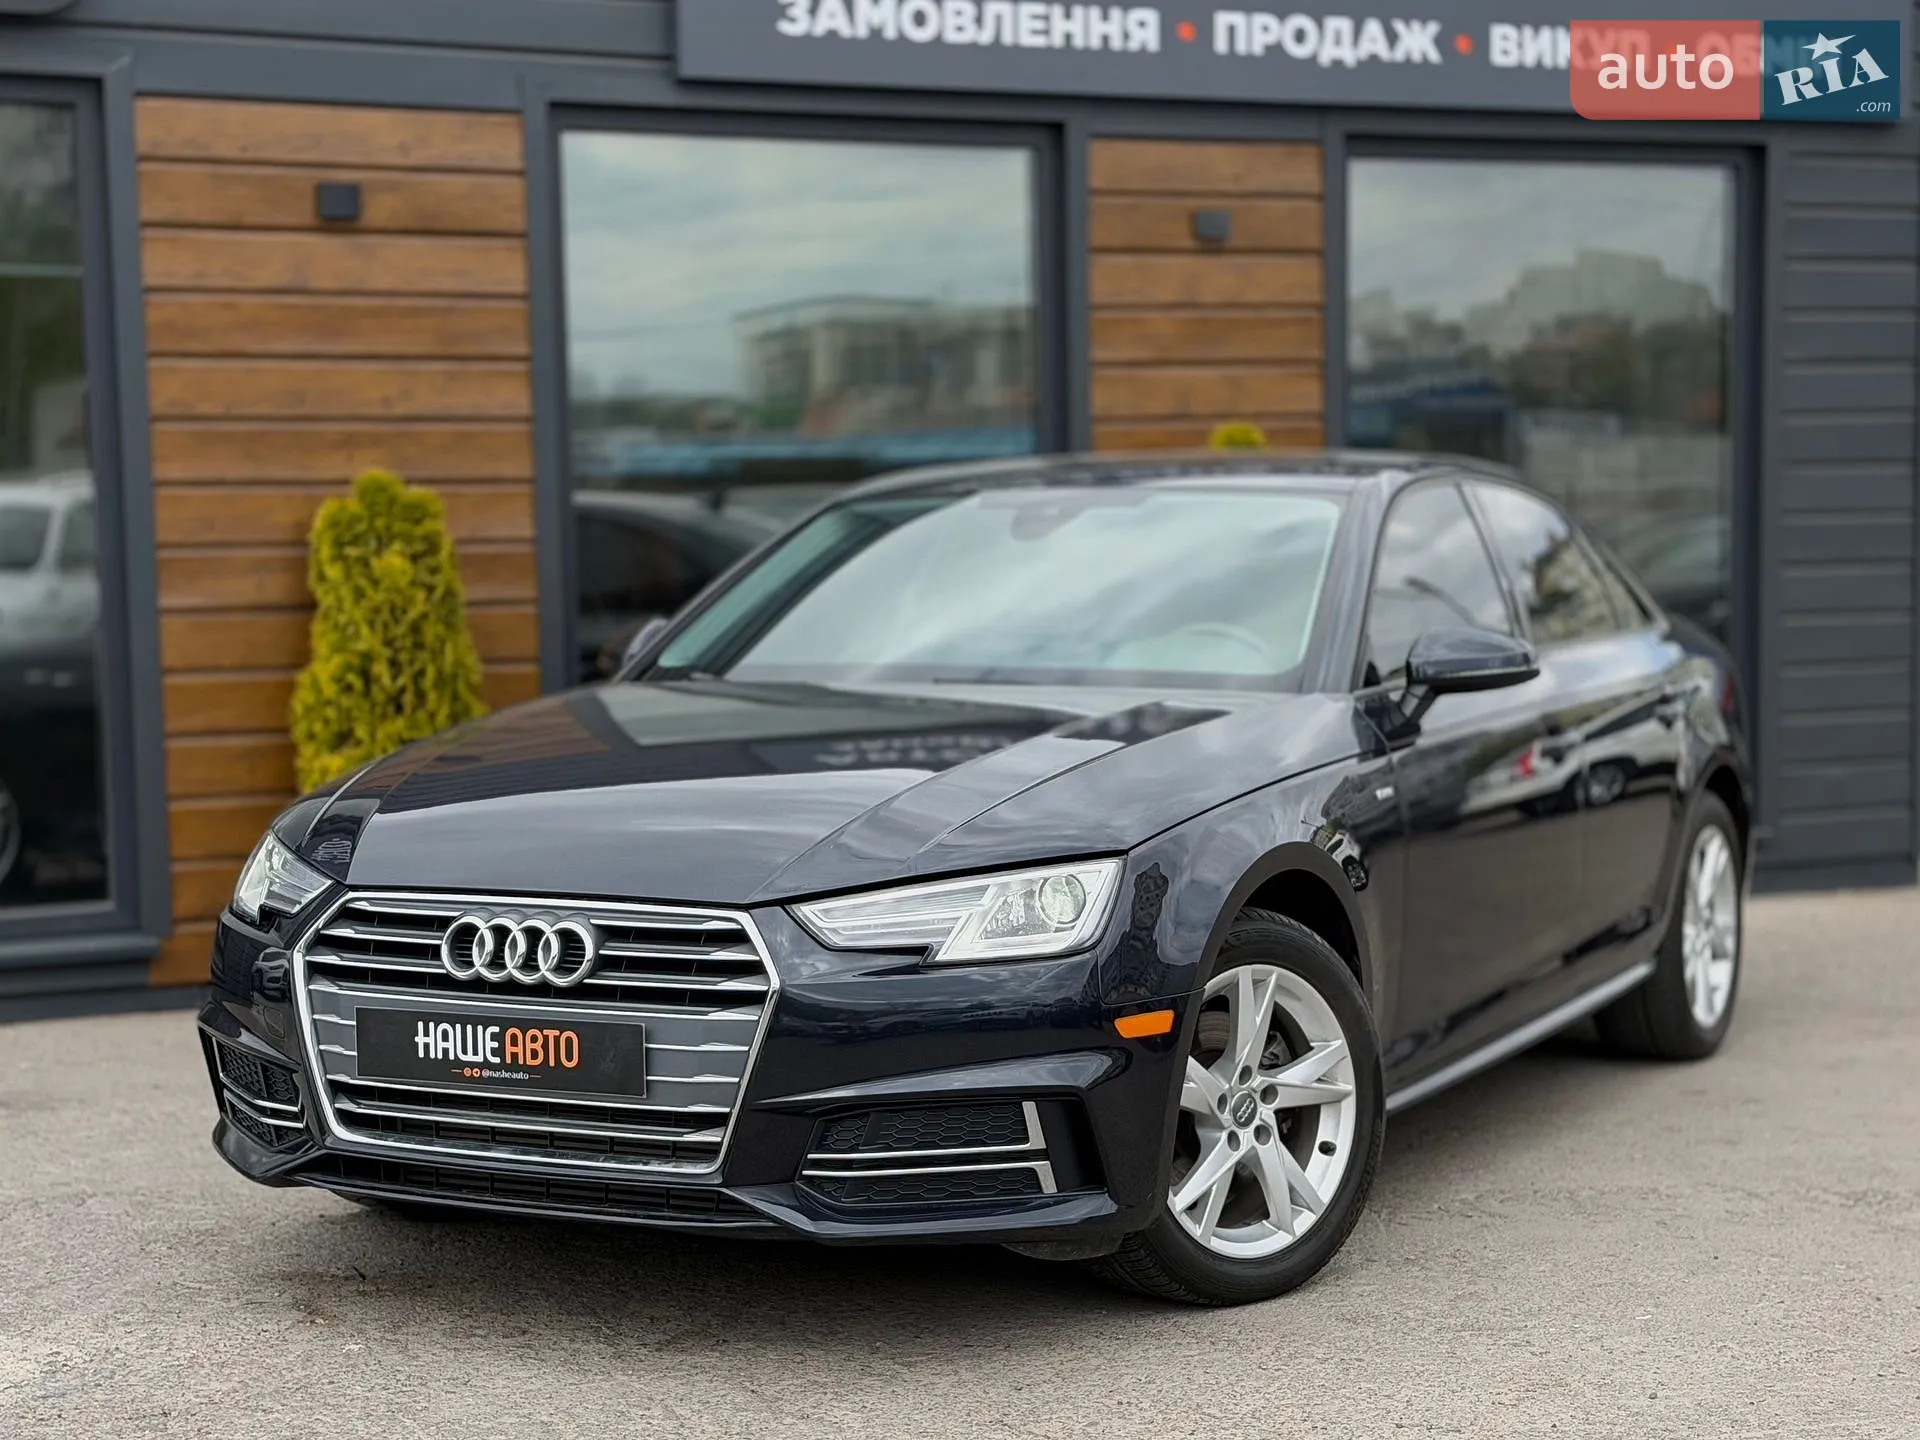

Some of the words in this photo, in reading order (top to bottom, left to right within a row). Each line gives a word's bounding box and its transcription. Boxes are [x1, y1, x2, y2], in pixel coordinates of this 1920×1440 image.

[775, 0, 1161, 52] ЗАМОВЛЕННЯ
[1212, 10, 1443, 68] ПРОДАЖ
[481, 1068, 529, 1080] @nasheauto
